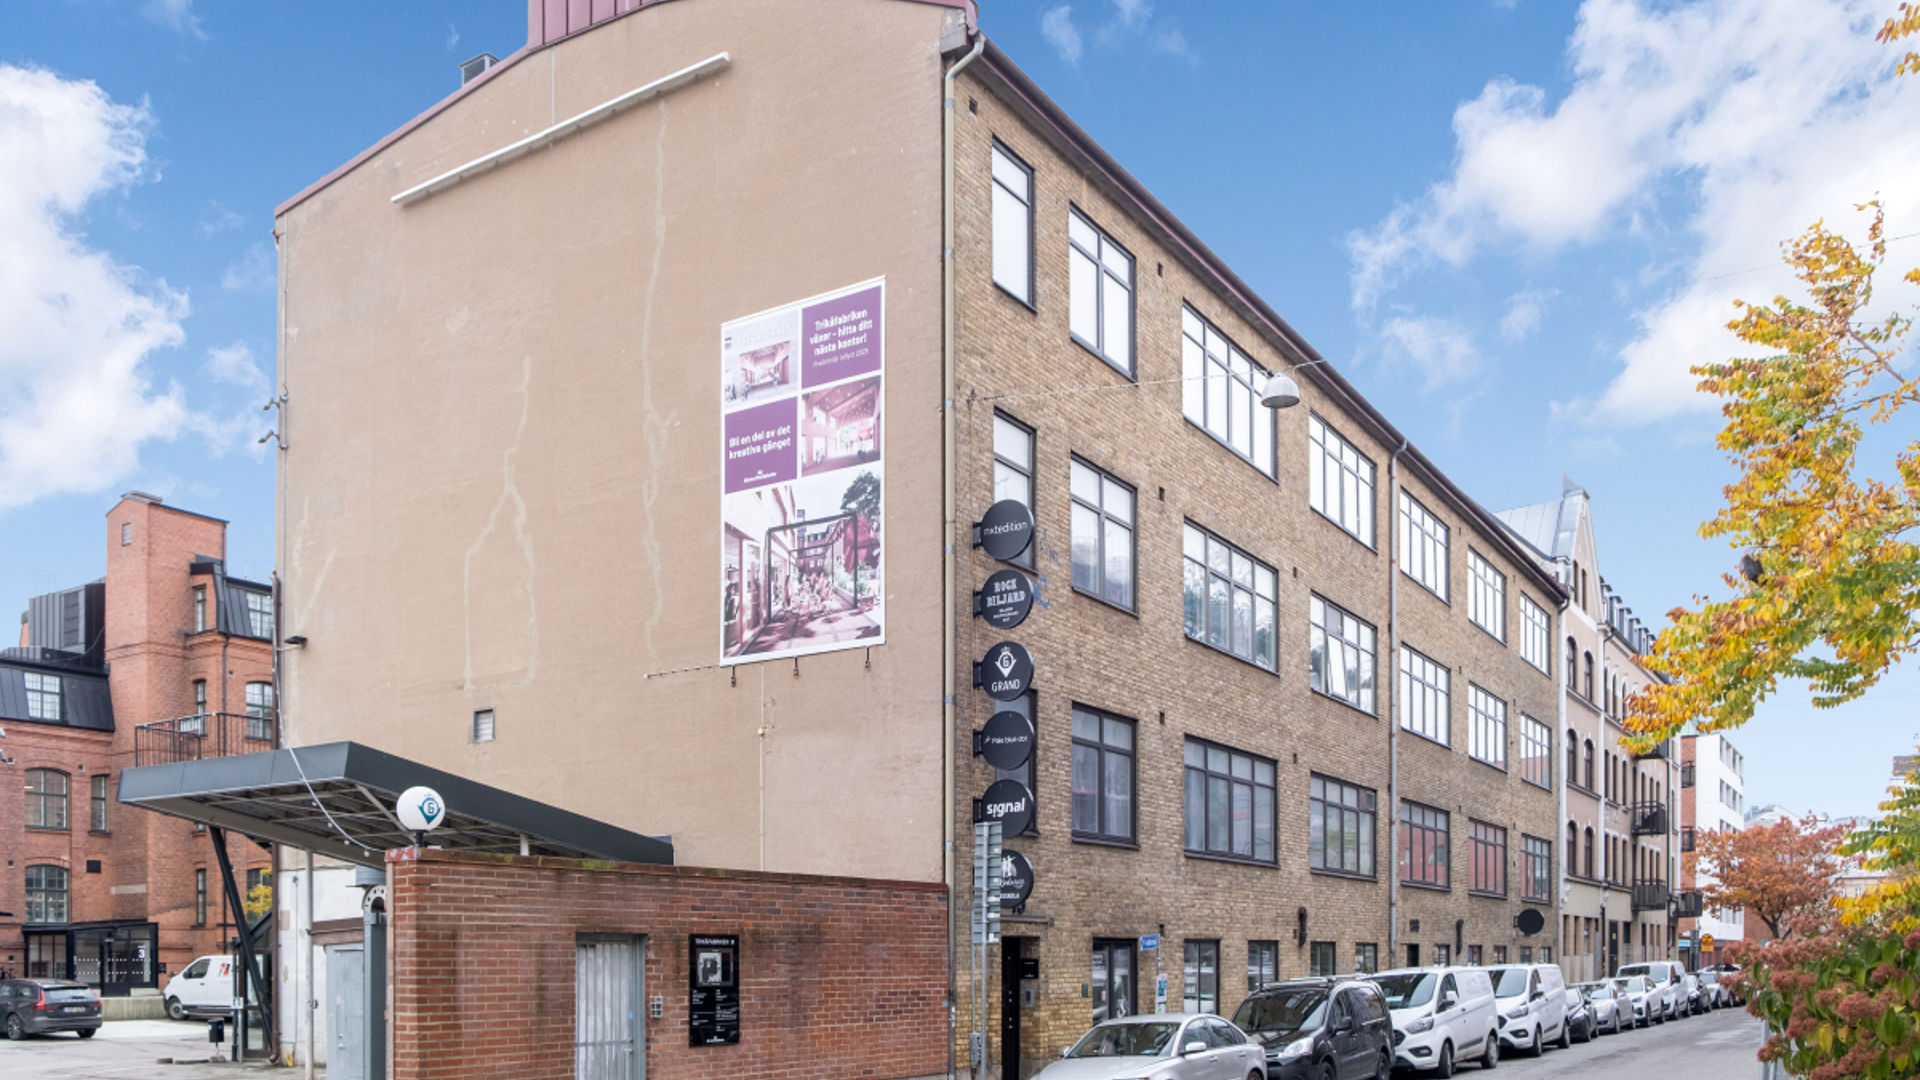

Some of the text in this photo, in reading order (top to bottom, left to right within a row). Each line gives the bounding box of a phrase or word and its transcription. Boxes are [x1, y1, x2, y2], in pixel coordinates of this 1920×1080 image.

[815, 309, 868, 331] Trikåfabriken
[837, 325, 857, 337] hitta
[858, 319, 873, 332] ditt
[814, 332, 867, 356] nästa kontor!
[729, 424, 791, 448] Bli en del av det
[729, 436, 791, 460] kreativa gänget
[986, 590, 1025, 608] BILJARD
[991, 678, 1021, 693] GRAND
[986, 797, 1027, 818] signal
[138, 949, 145, 959] 3
